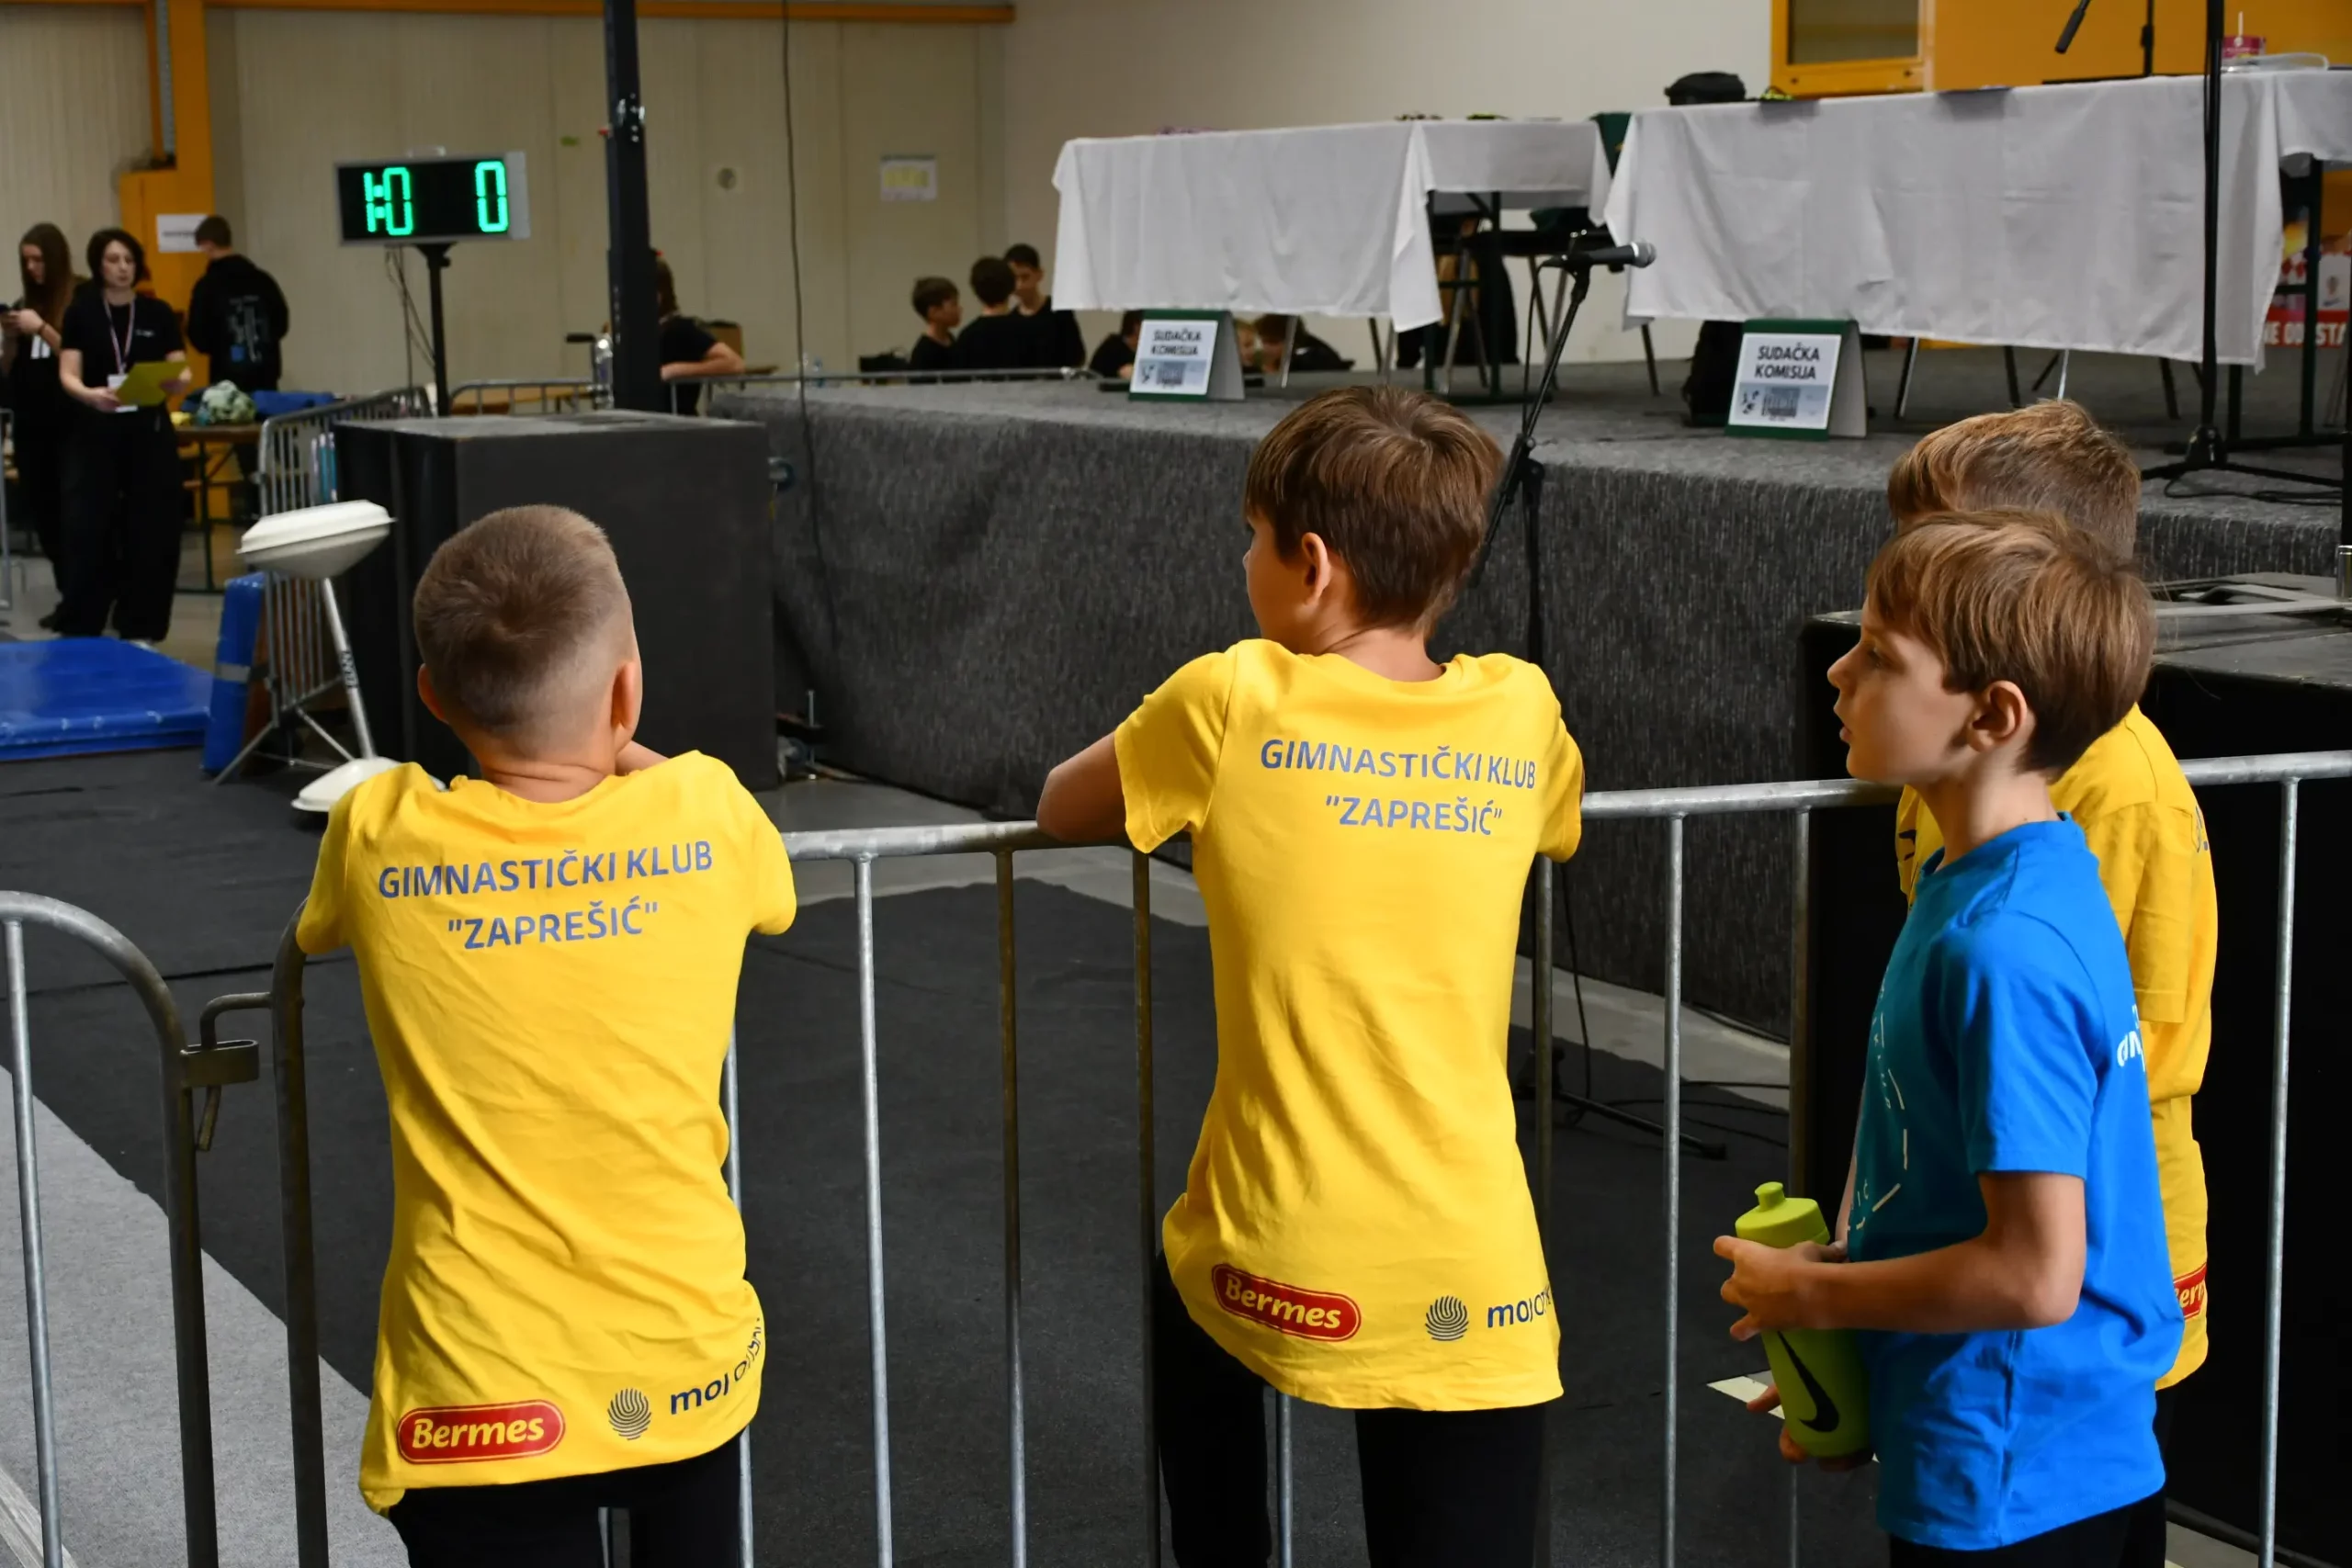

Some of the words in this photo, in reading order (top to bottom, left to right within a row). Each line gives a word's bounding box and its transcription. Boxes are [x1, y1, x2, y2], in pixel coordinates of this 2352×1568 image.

[1755, 365, 1816, 380] KOMISIJA
[1758, 343, 1820, 361] SUDAČKA
[1261, 739, 1482, 781] GIMNASTIČKI
[1487, 755, 1536, 789] KLUB
[1326, 795, 1503, 836] "ZAPREŠIĆ"
[379, 849, 616, 899] GIMNASTIČKI
[627, 840, 713, 879] KLUB
[448, 896, 659, 950] "ZAPREŠIĆ"
[1225, 1274, 1341, 1330] Bermes
[412, 1416, 545, 1450] Bermes
